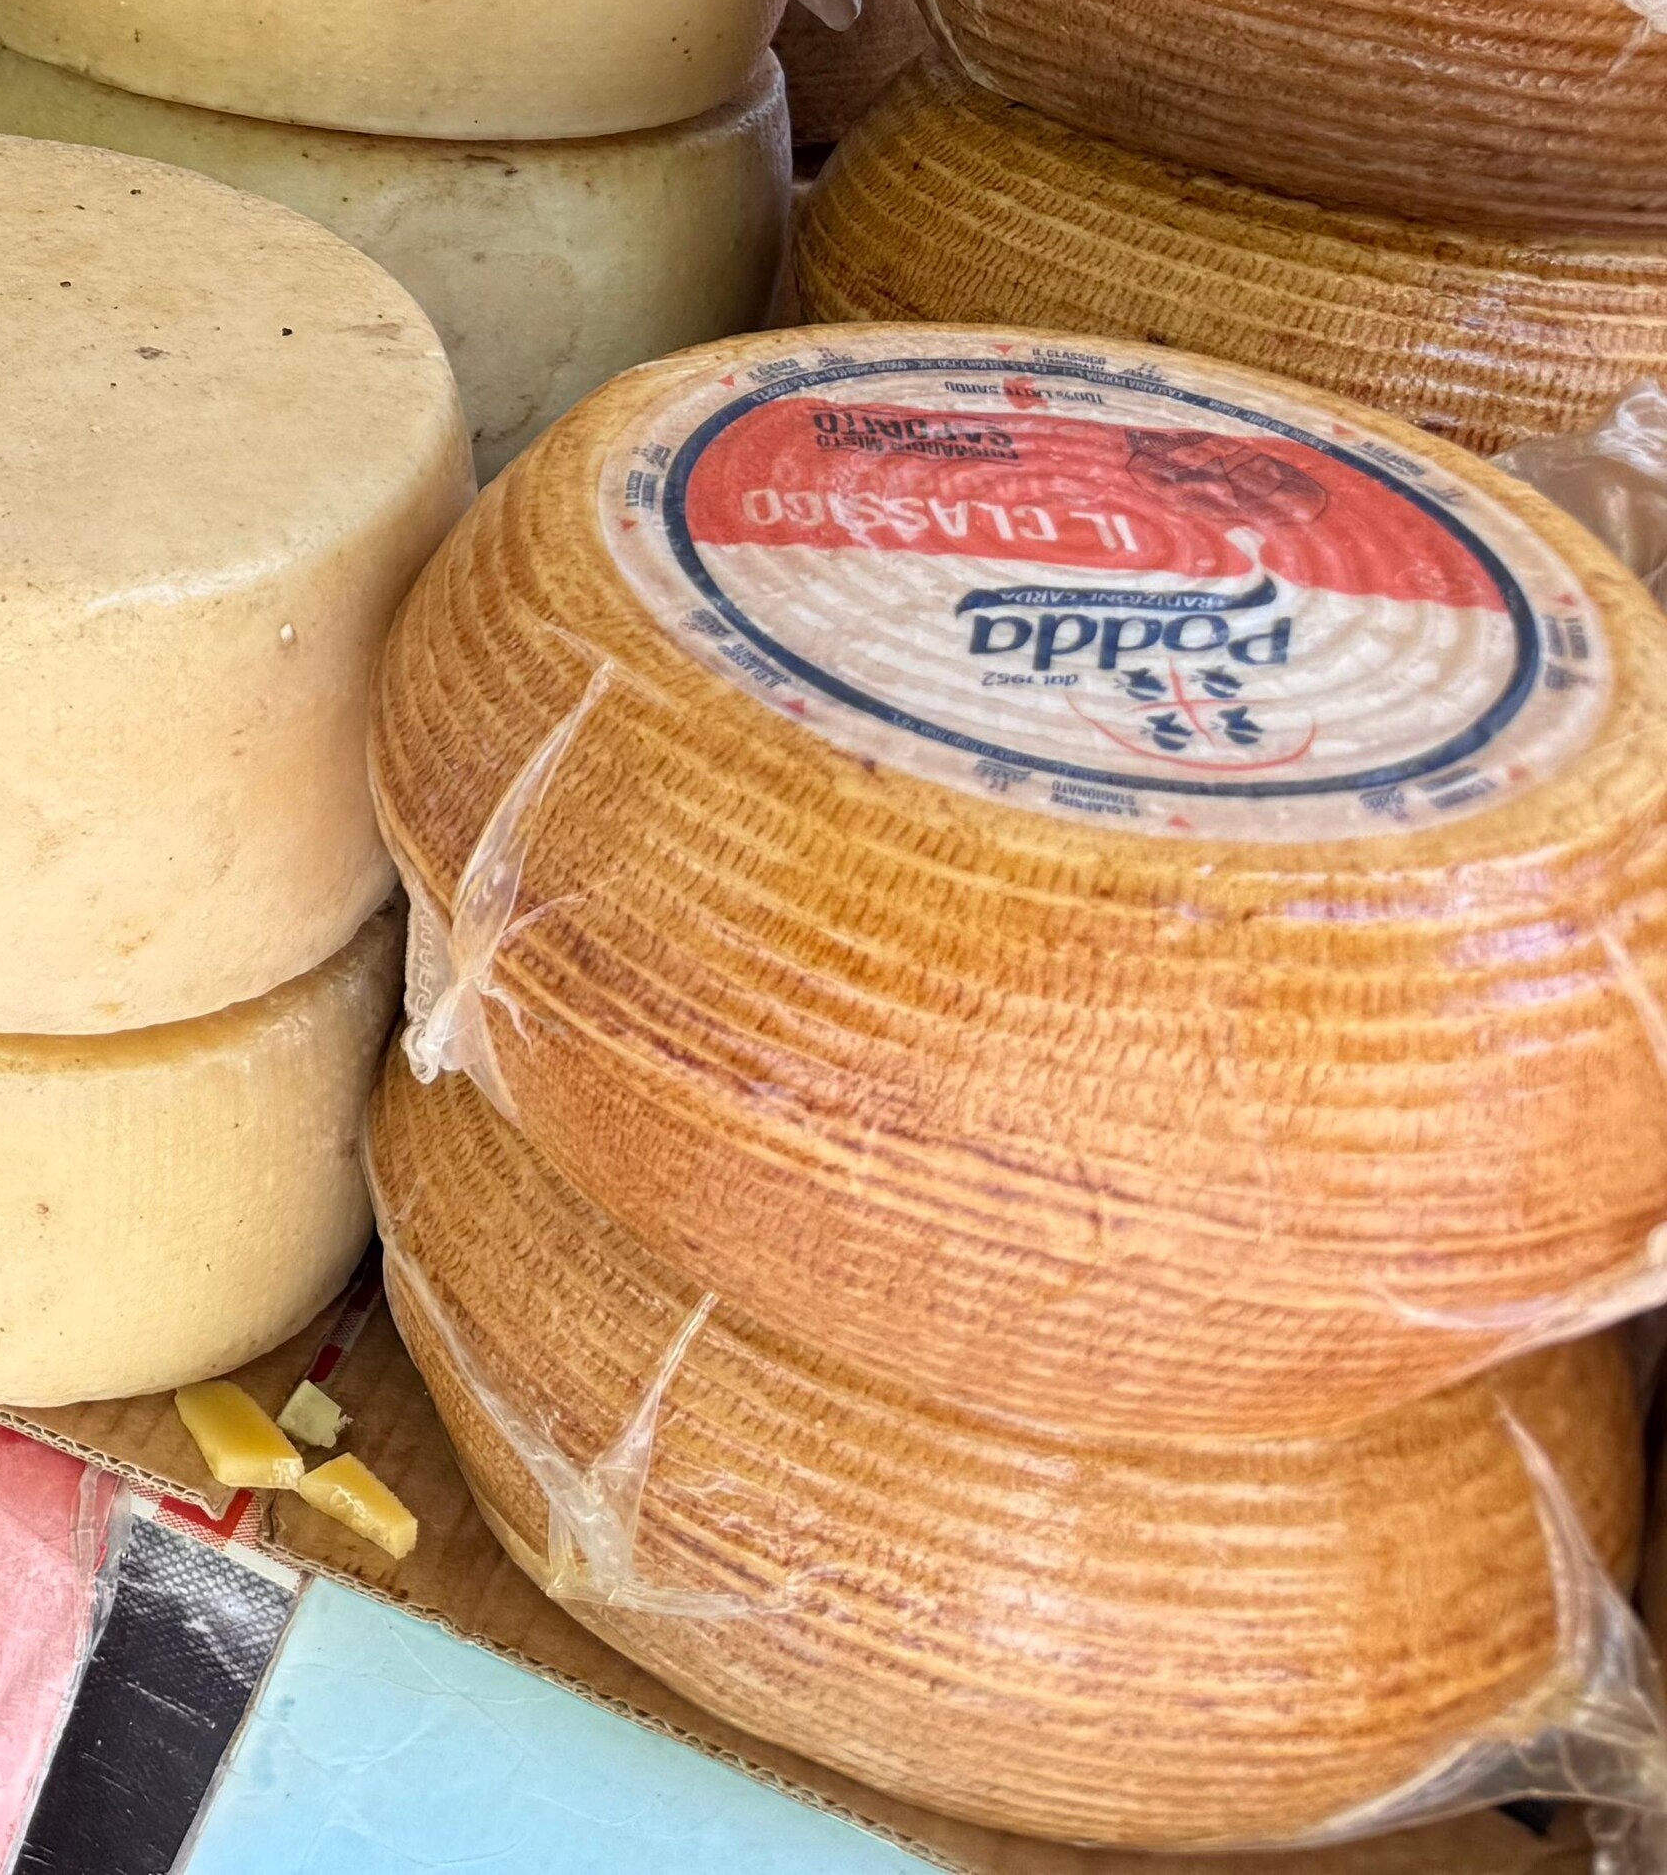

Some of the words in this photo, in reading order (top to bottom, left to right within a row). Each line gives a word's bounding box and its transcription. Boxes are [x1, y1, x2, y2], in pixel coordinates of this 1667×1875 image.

[741, 487, 1060, 546] CLASSICO
[1069, 511, 1139, 553] IL
[969, 613, 1294, 672] Podda
